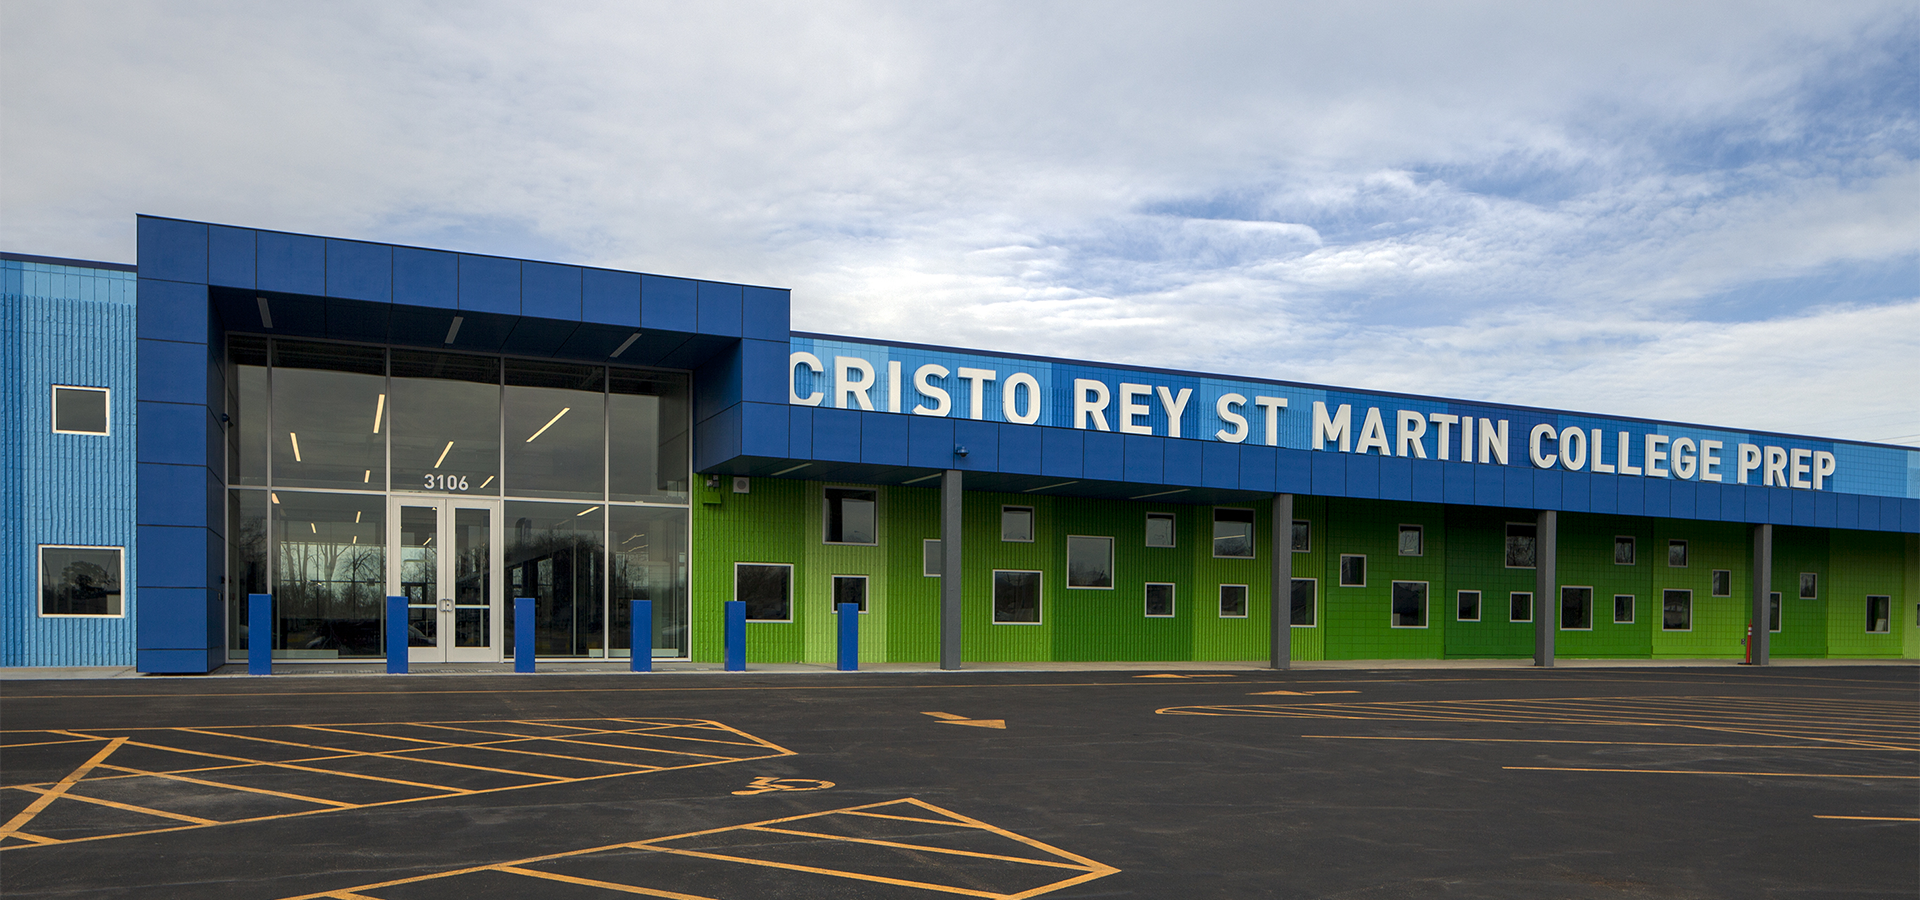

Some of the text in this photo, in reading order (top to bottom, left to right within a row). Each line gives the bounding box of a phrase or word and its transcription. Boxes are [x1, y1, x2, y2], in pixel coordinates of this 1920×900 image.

[789, 351, 1836, 490] CRISTO REY ST MARTIN COLLEGE PREP
[424, 473, 469, 491] 3106
